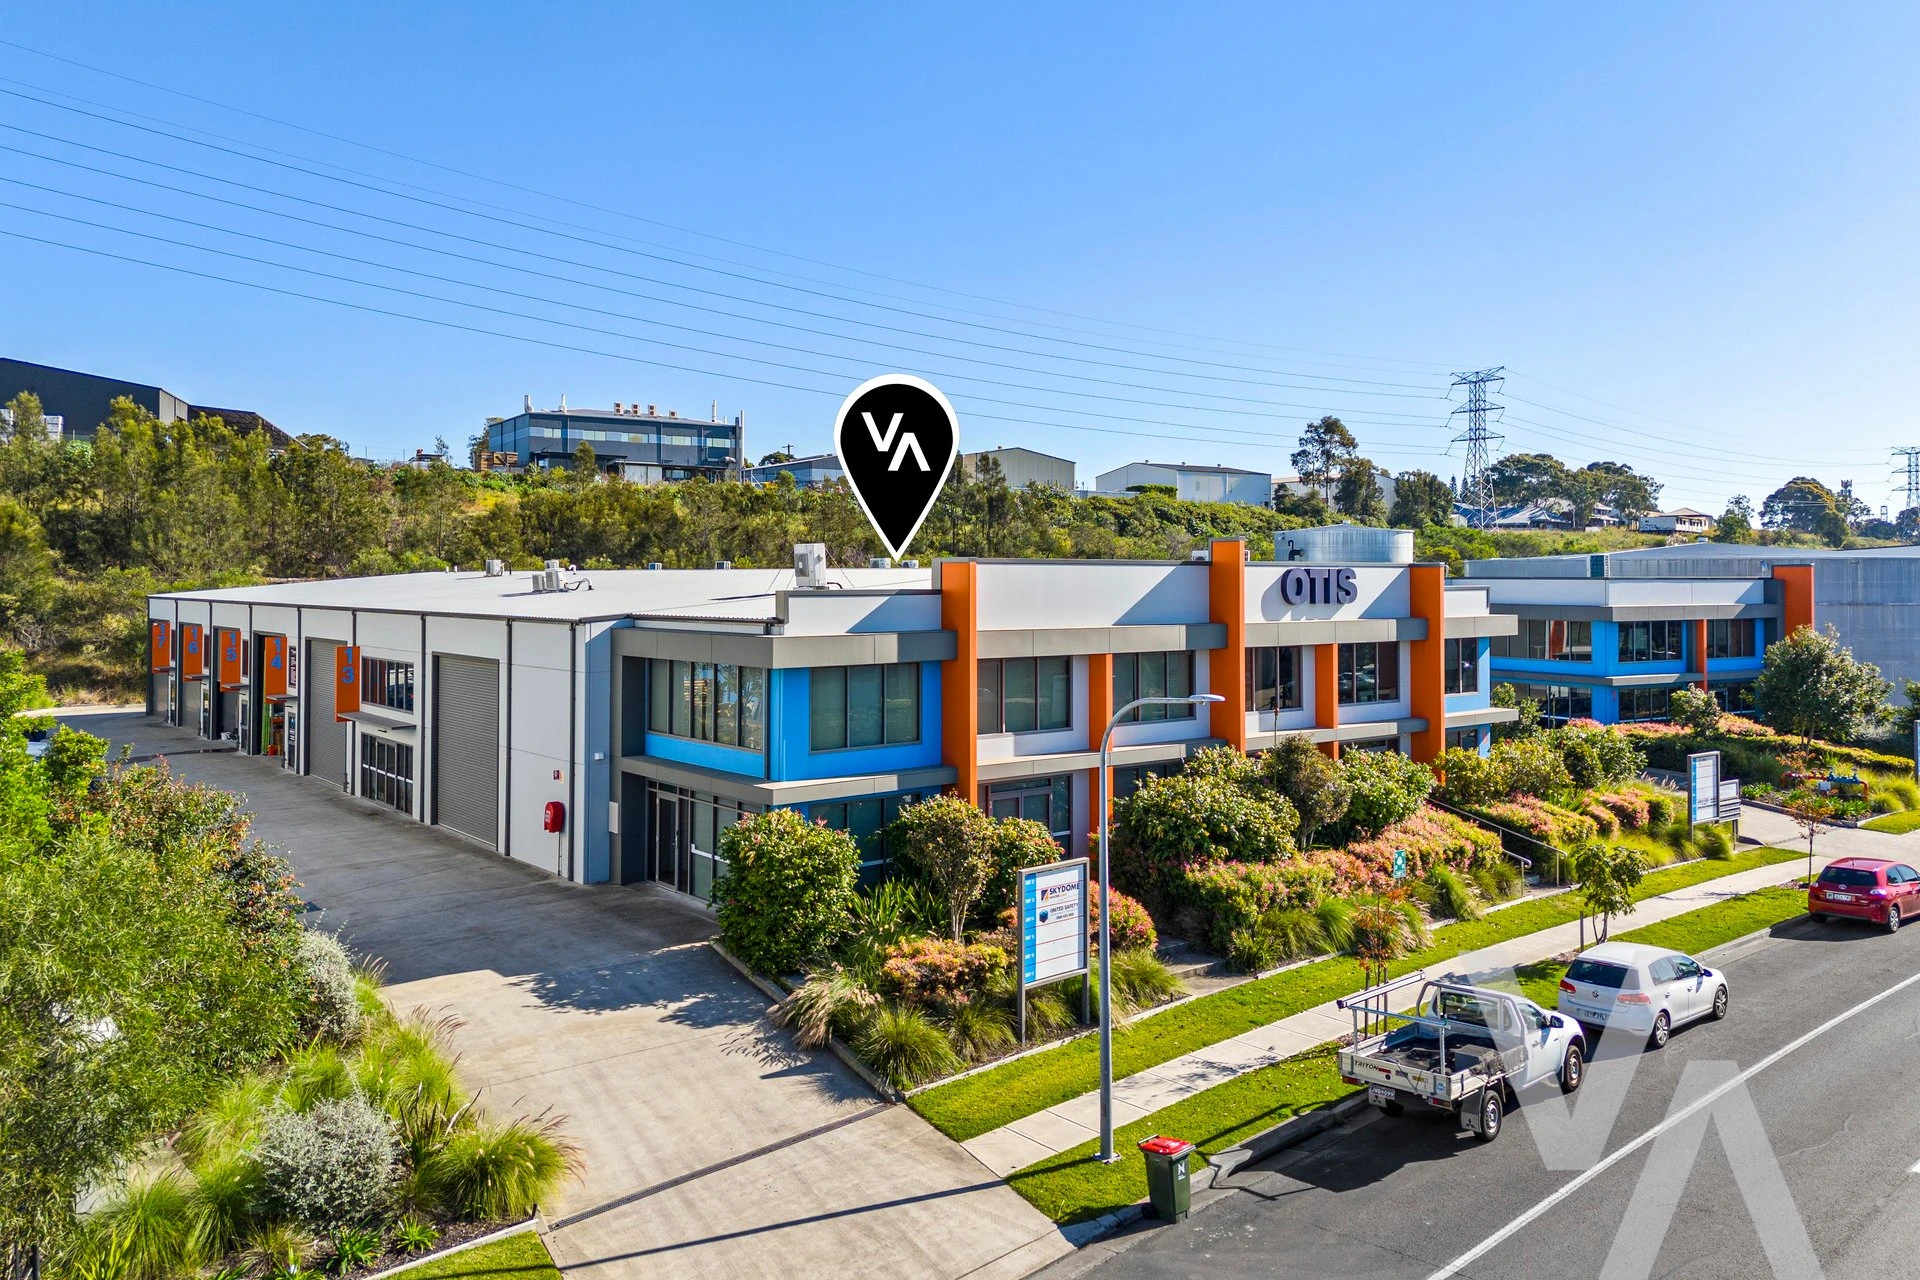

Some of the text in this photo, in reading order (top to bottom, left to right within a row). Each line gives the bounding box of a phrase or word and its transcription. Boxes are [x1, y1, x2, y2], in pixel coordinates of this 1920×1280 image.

[1281, 568, 1358, 605] OTIS
[188, 626, 199, 654] 16
[226, 631, 237, 662] 15
[271, 638, 282, 670] 14
[341, 647, 355, 684] 13
[1050, 883, 1080, 895] SKYDOME
[1354, 1060, 1379, 1071] TRITON
